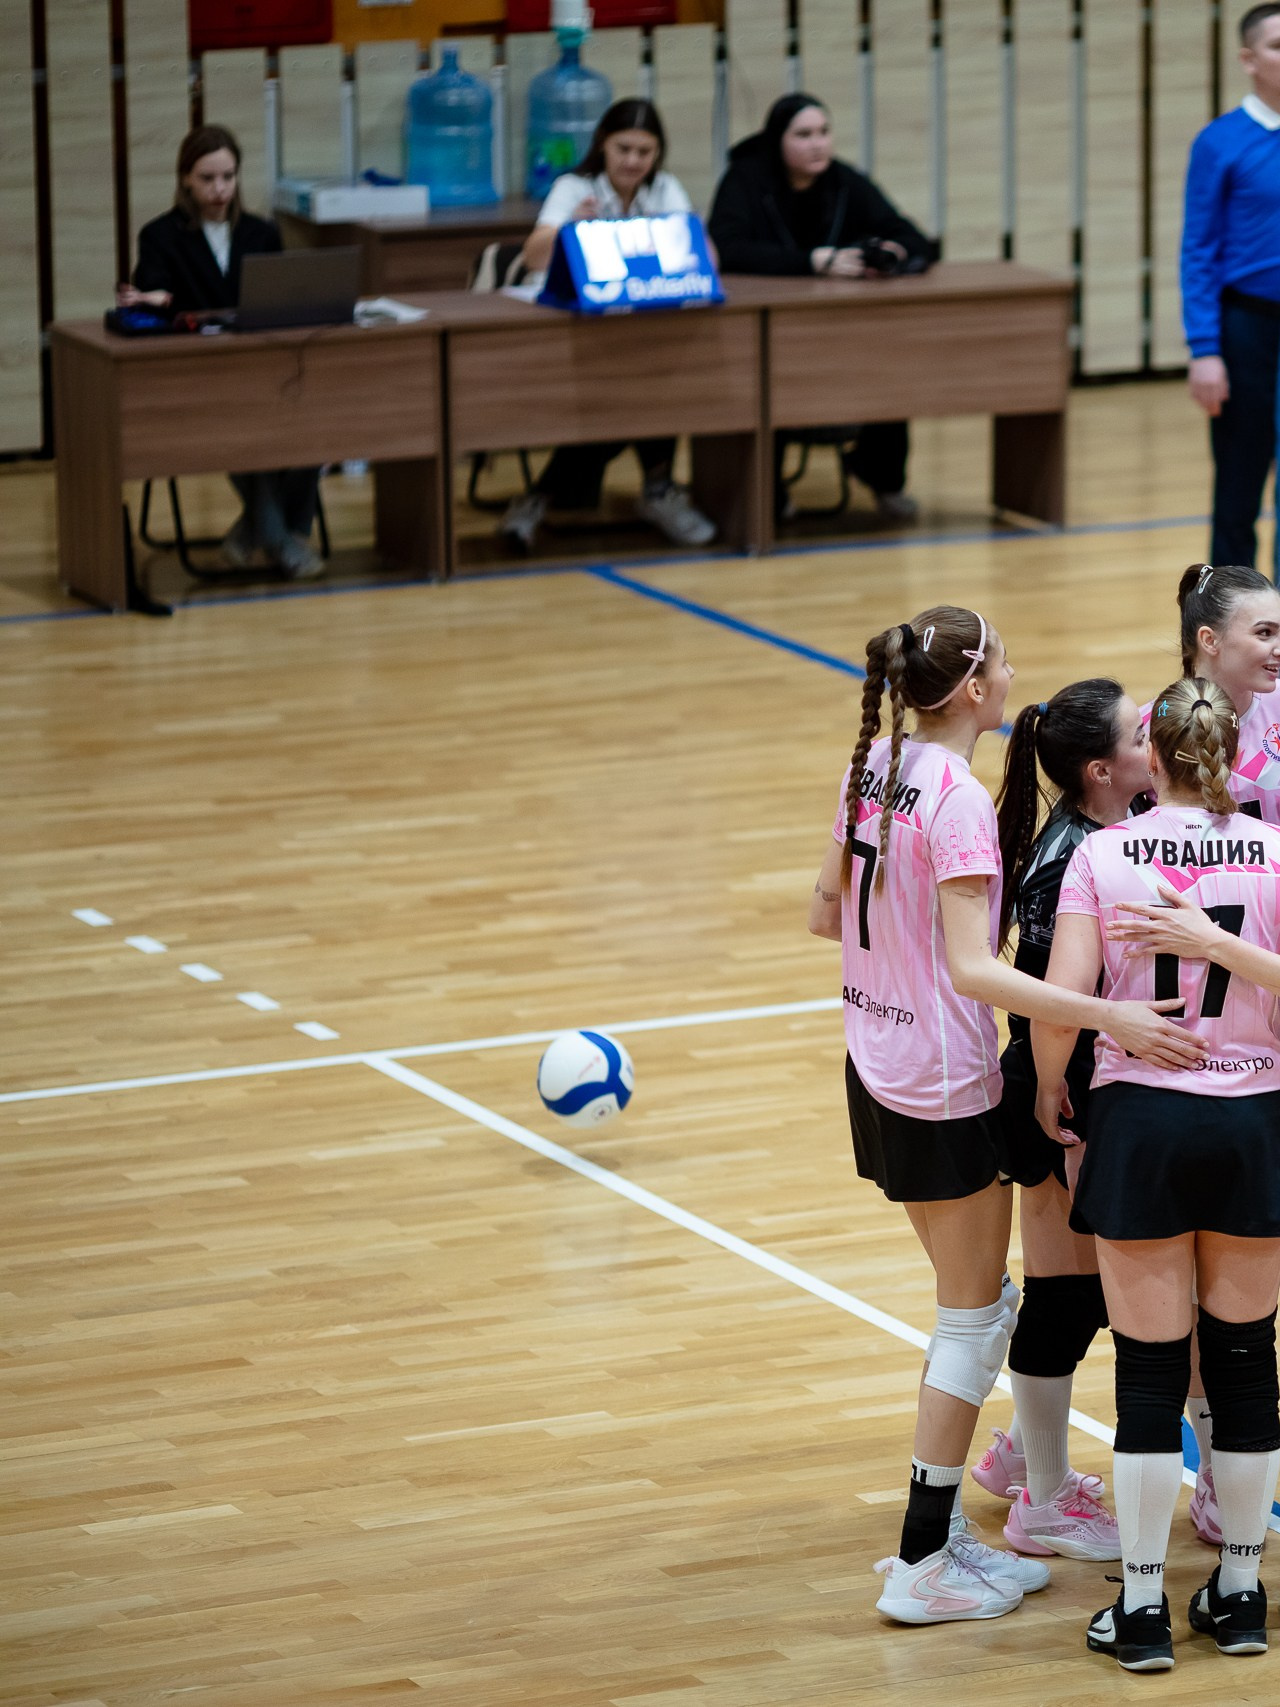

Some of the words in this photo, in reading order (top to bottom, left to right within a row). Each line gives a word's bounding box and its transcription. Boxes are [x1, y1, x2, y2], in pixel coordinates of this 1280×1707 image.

[851, 836, 878, 952] 7
[1123, 838, 1265, 868] ЧУВАШИЯ
[1148, 904, 1246, 1018] 17
